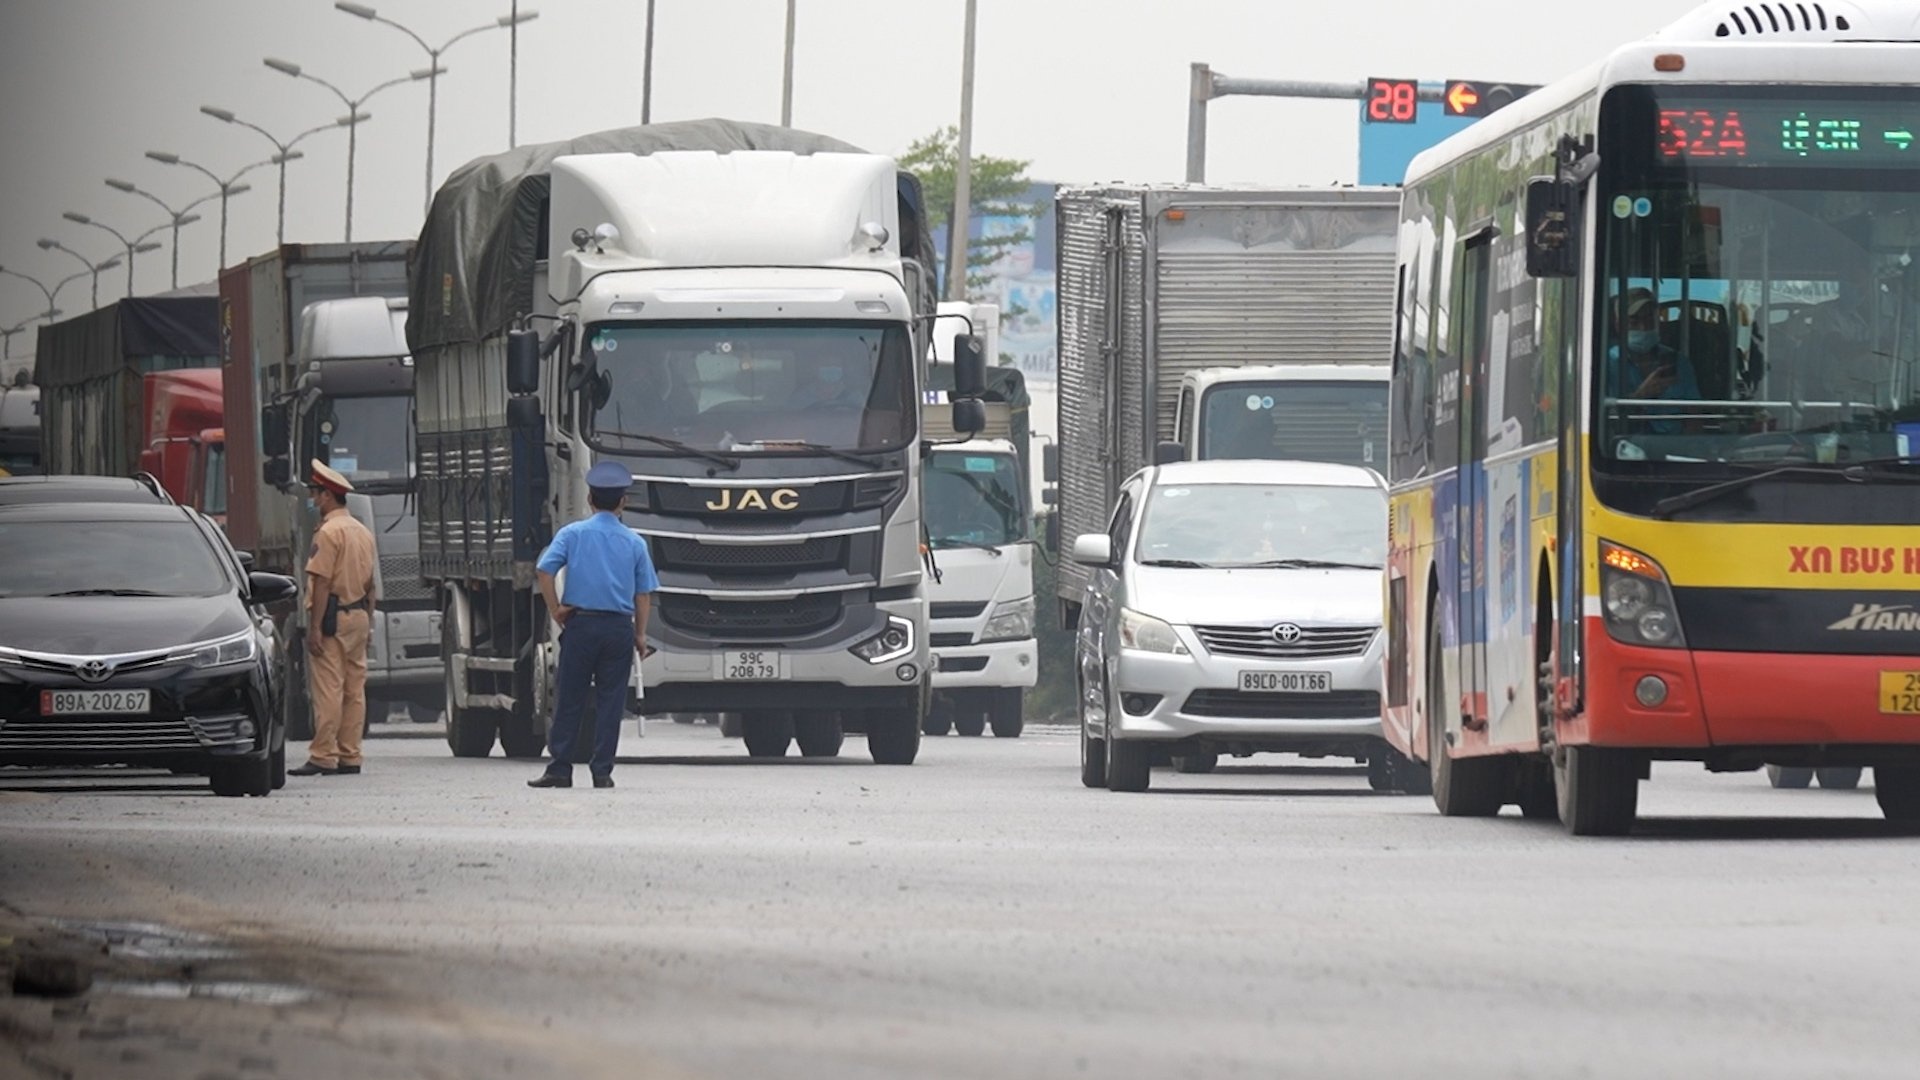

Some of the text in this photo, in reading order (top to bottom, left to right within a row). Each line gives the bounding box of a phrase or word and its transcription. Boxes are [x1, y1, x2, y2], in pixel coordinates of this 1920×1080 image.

[1370, 82, 1415, 120] 28
[1659, 111, 1746, 155] 52A
[705, 488, 799, 511] JAC
[1840, 546, 1895, 574] BUS
[739, 652, 764, 664] 99C
[729, 665, 775, 678] 208.79
[54, 692, 147, 712] 89A-202.67
